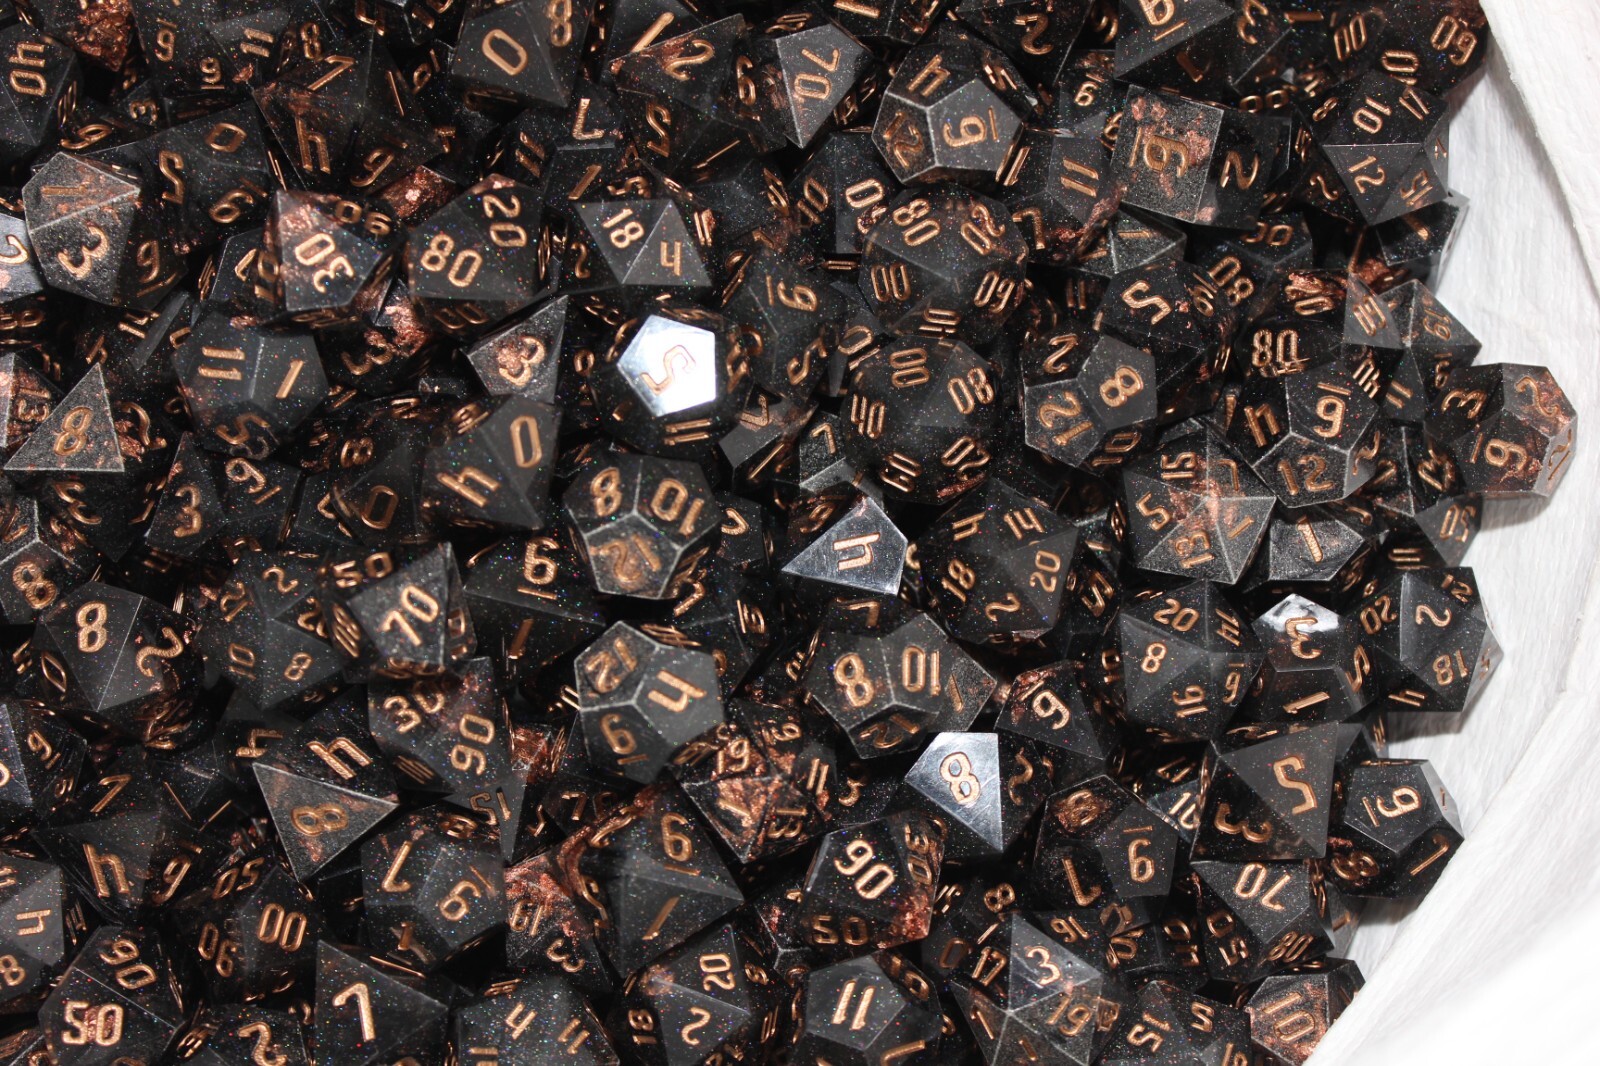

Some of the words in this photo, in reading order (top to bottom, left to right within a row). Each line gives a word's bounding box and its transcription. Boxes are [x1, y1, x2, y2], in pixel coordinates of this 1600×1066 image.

[793, 48, 838, 100] 70
[1353, 97, 1392, 135] 10
[1347, 155, 1387, 194] 12
[482, 194, 529, 248] 20
[600, 208, 645, 249] 18
[893, 198, 941, 247] 80
[57, 224, 110, 278] 3
[420, 234, 483, 288] 80
[660, 240, 681, 277] 4
[198, 346, 246, 381] 11
[1099, 365, 1144, 408] 8
[947, 366, 996, 415] 80
[53, 405, 93, 456] 8
[510, 415, 543, 469] 0
[1037, 391, 1094, 446] 12
[1275, 455, 1334, 498] 12
[174, 485, 202, 538] 3
[650, 479, 705, 536] 10
[1003, 507, 1047, 540] 14
[12, 561, 57, 609] 8
[516, 536, 560, 600] 6
[942, 558, 976, 602] 18
[1030, 549, 1061, 593] 20
[75, 600, 108, 653] 8
[382, 585, 440, 646] 70
[1152, 598, 1200, 632] 20
[1415, 604, 1452, 629] 2
[283, 652, 312, 682] 8
[832, 652, 874, 707] 8
[900, 645, 942, 697] 10
[1140, 642, 1167, 675] 8
[1432, 649, 1469, 687] 18
[647, 669, 708, 713] 4
[939, 751, 981, 805] 8
[290, 803, 347, 837] 8
[833, 838, 896, 900] 90
[1234, 863, 1296, 911] 70
[984, 882, 1016, 913] 8
[257, 902, 307, 952] 00
[699, 952, 736, 992] 20
[1023, 945, 1061, 990] 3
[61, 1000, 125, 1047] 50
[332, 982, 377, 1042] 7
[504, 1001, 538, 1041] 4
[681, 1006, 712, 1047] 2
[830, 978, 878, 1032] 11
